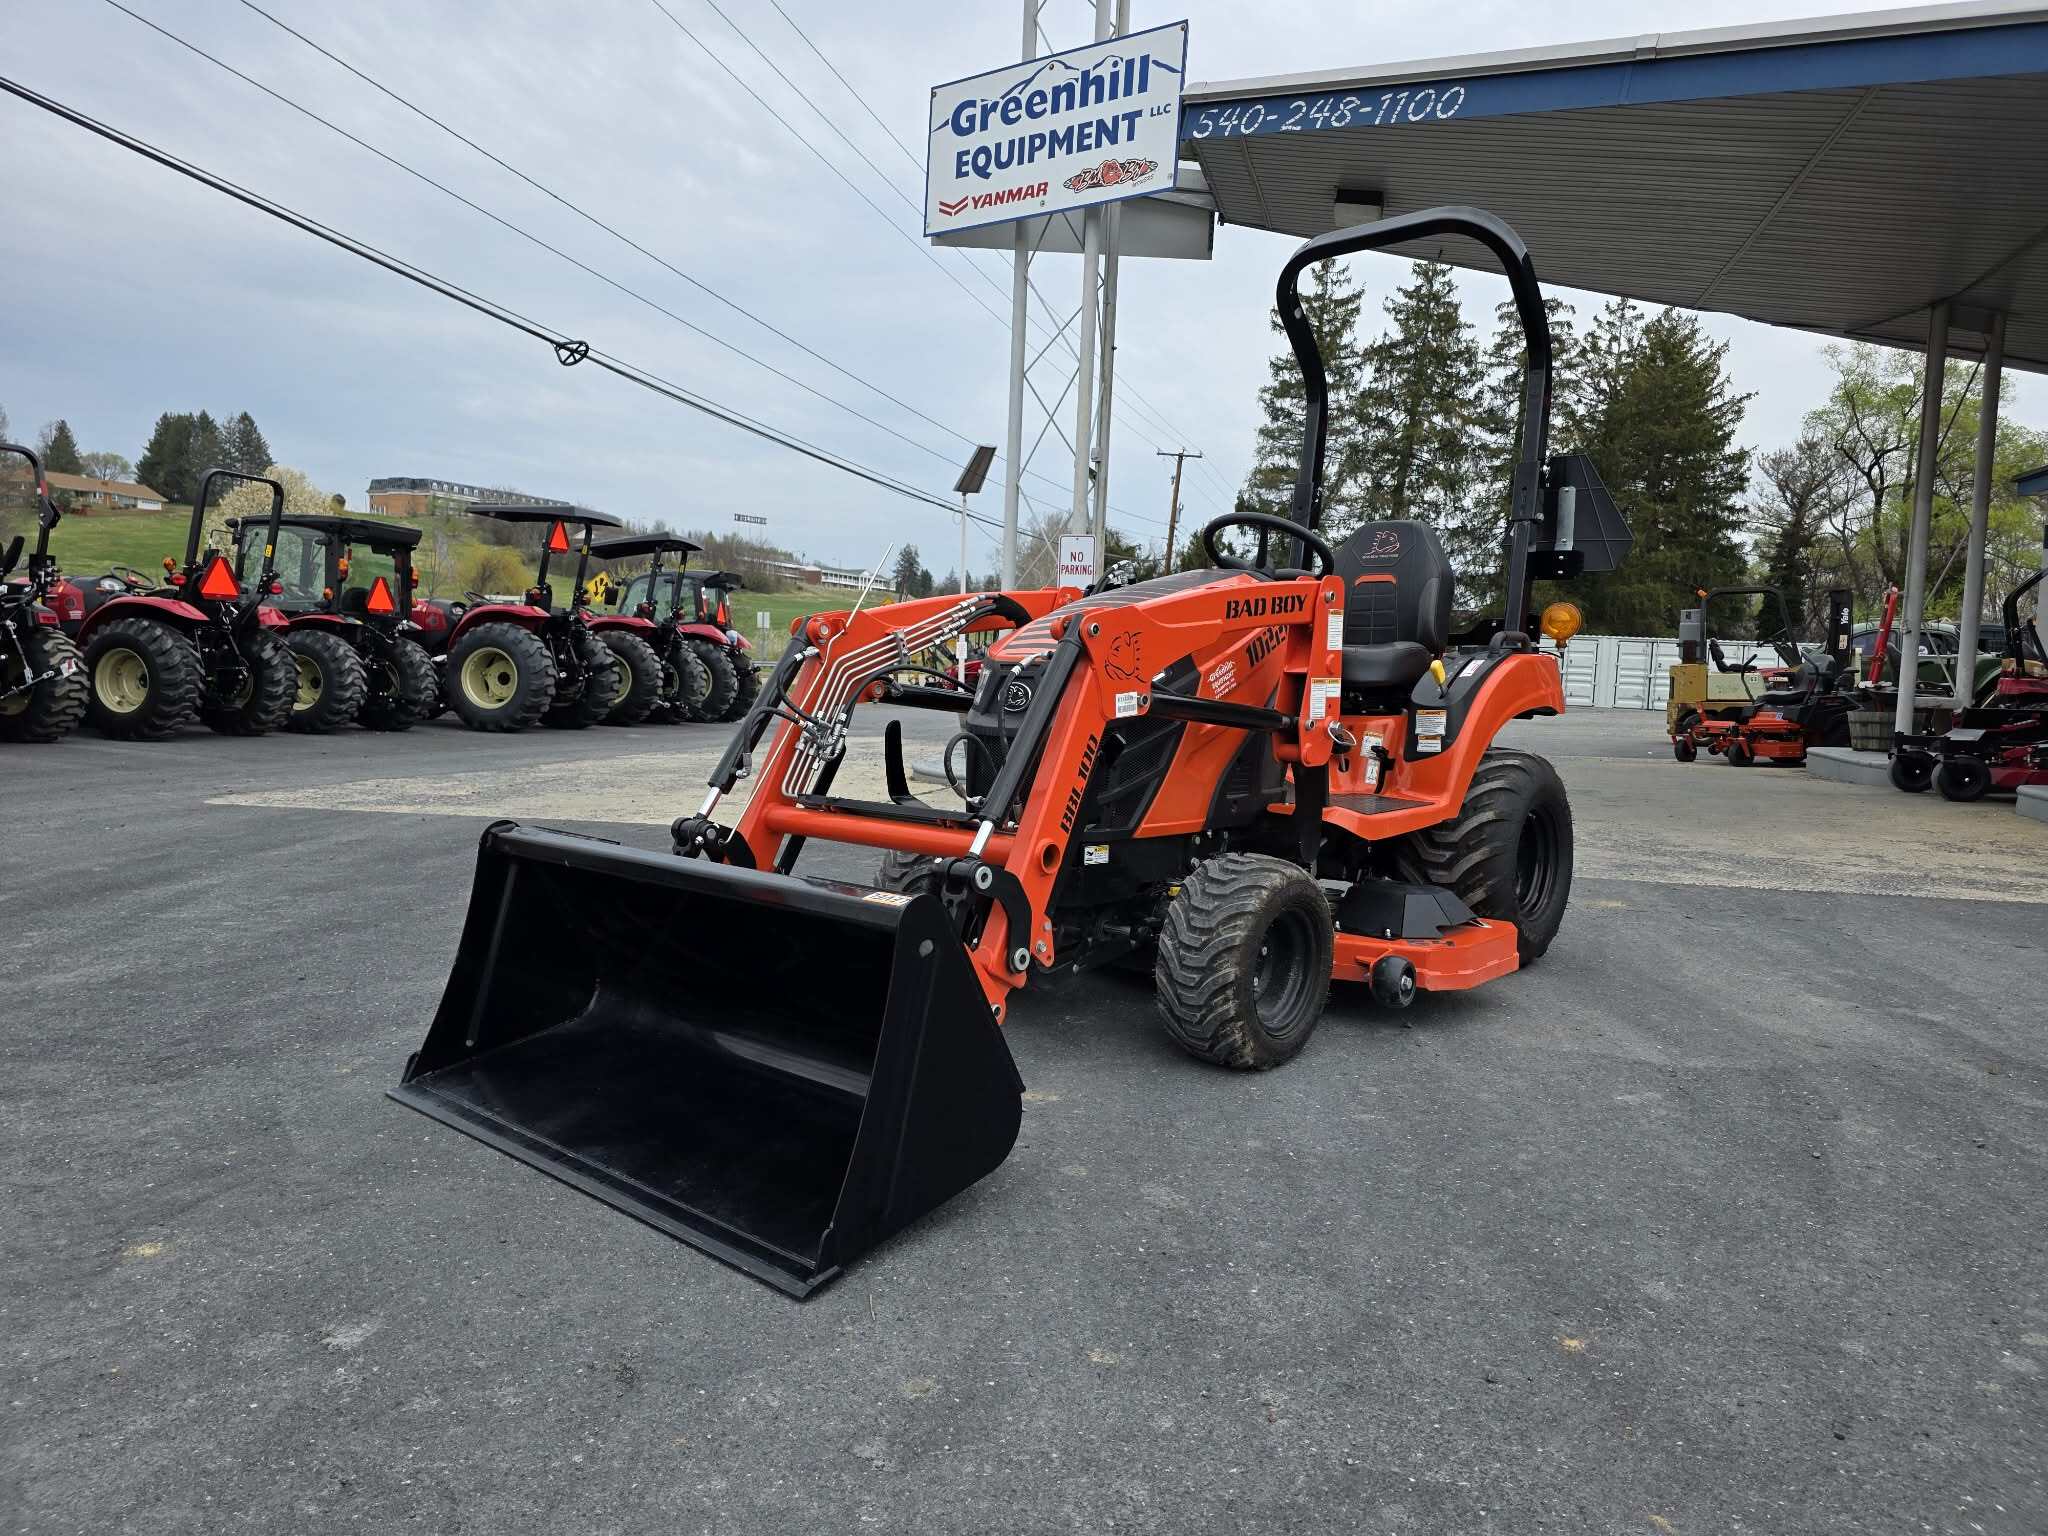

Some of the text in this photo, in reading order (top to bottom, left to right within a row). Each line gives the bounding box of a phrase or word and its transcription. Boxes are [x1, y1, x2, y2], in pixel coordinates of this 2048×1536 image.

[951, 54, 1150, 137] Greenhill
[1192, 86, 1465, 138] 540-248-1100
[955, 103, 1171, 180] EQUIPMENT LLC
[971, 182, 1049, 210] YANMAR
[1060, 564, 1093, 576] PARKING
[1070, 551, 1084, 562] NO
[1226, 594, 1308, 619] BAD BOY
